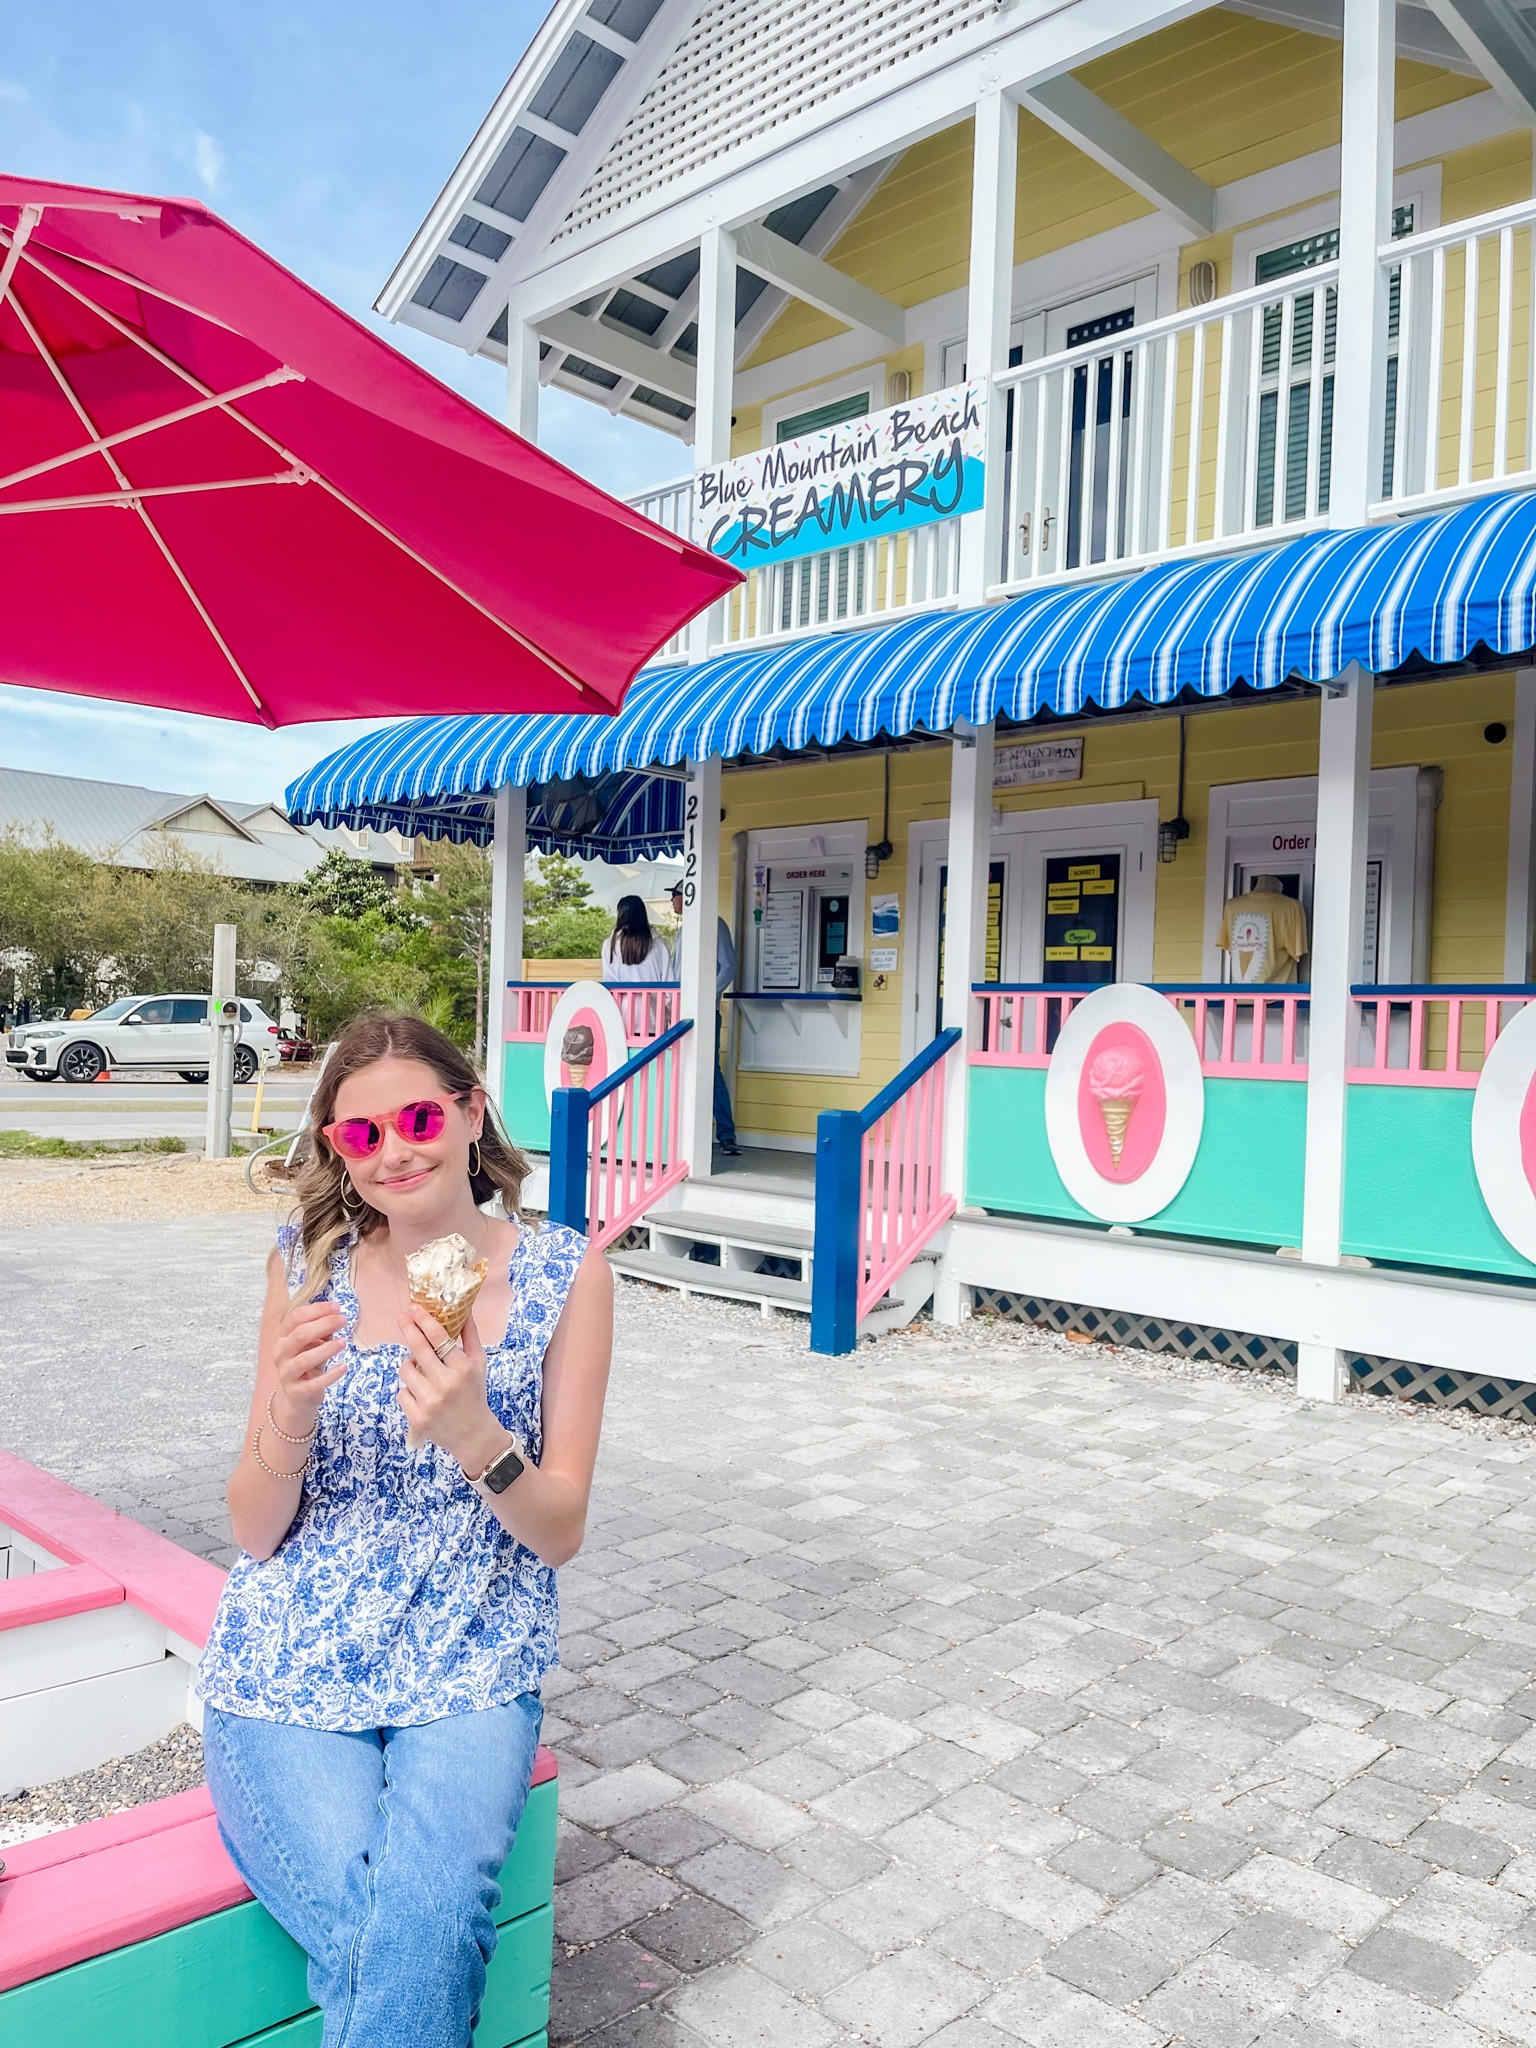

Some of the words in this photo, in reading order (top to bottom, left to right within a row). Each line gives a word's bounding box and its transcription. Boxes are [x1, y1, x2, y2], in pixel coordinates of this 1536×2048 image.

[699, 469, 752, 510] Blue
[761, 433, 877, 490] Mountain
[890, 391, 980, 452] Beach
[707, 437, 964, 560] CREAMERY
[1009, 746, 1078, 761] MOUNTAIN
[1272, 834, 1311, 851] Order
[786, 870, 808, 879] ORDER
[809, 869, 827, 878] HERE
